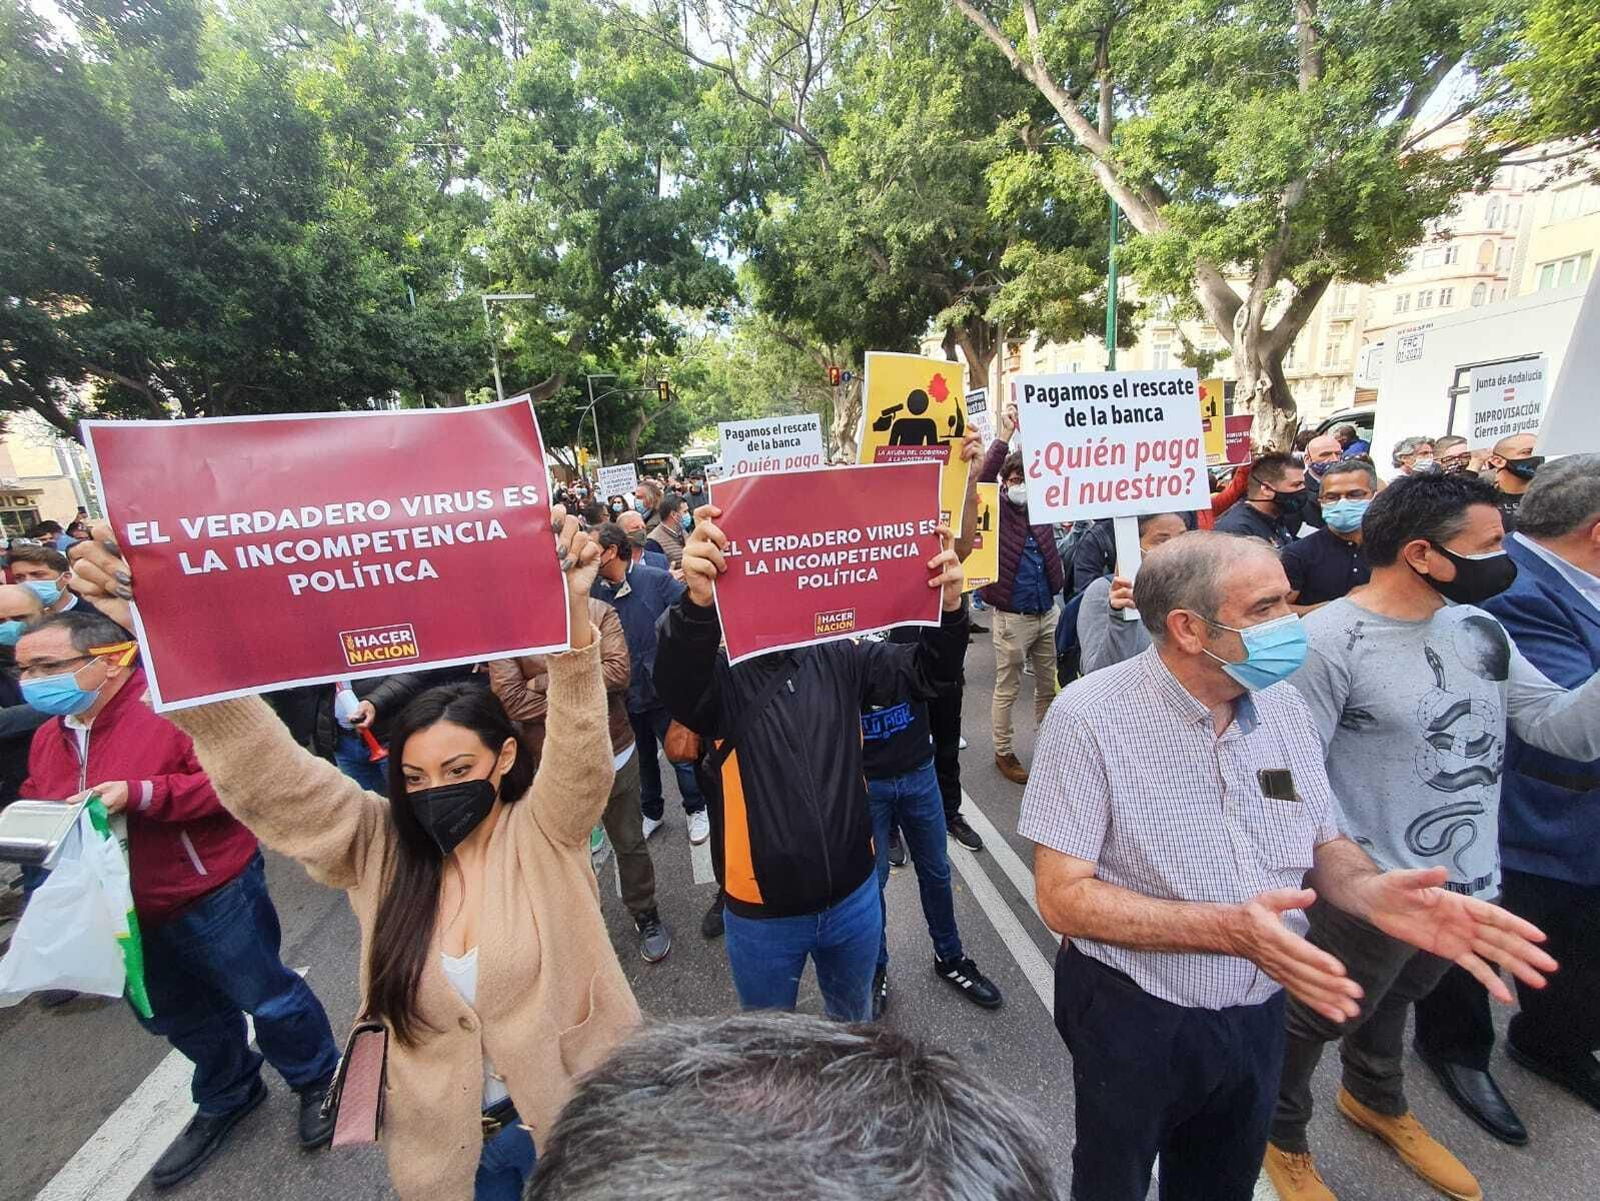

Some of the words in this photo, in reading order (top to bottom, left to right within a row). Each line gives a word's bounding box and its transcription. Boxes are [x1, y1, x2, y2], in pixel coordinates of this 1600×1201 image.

[1475, 378, 1496, 392] Junta
[1497, 374, 1507, 386] de
[1507, 369, 1542, 384] Andalucía
[1024, 384, 1109, 408] Pagamos
[1112, 379, 1128, 398] el
[1132, 378, 1194, 397] rescate
[1064, 407, 1087, 427] de
[1090, 406, 1107, 426] la
[1111, 405, 1164, 425] banca
[1474, 402, 1540, 424] IMPROVISACIÓN
[725, 427, 771, 441] Pagamos
[772, 424, 781, 436] el
[783, 422, 817, 434] rescate
[1474, 425, 1498, 438] Cierre
[1499, 422, 1511, 434] sin
[1512, 417, 1539, 434] ayudas
[747, 440, 759, 452] de
[761, 439, 771, 450] la
[772, 438, 801, 449] banca
[1028, 436, 1126, 479] ¿Quién
[1135, 436, 1200, 472] paga
[1045, 477, 1071, 508] el
[1079, 467, 1196, 505] nuestro?
[127, 521, 170, 546] EL
[179, 499, 391, 539] VERDADERO
[400, 489, 494, 518] VIRUS
[502, 485, 539, 507] ES
[179, 549, 228, 575] LA
[235, 518, 508, 569] INCOMPETENCIA
[747, 528, 861, 554] VERDADERO
[866, 523, 914, 541] VIRUS
[919, 519, 936, 535] ES
[745, 560, 769, 576] LA
[774, 542, 920, 573] INCOMPETENCIA
[288, 558, 439, 596] POLÍTICA
[797, 568, 878, 590] POLÍTICA
[822, 611, 853, 624] HACER
[354, 630, 412, 648] HACER
[349, 643, 416, 663] NACIÓN
